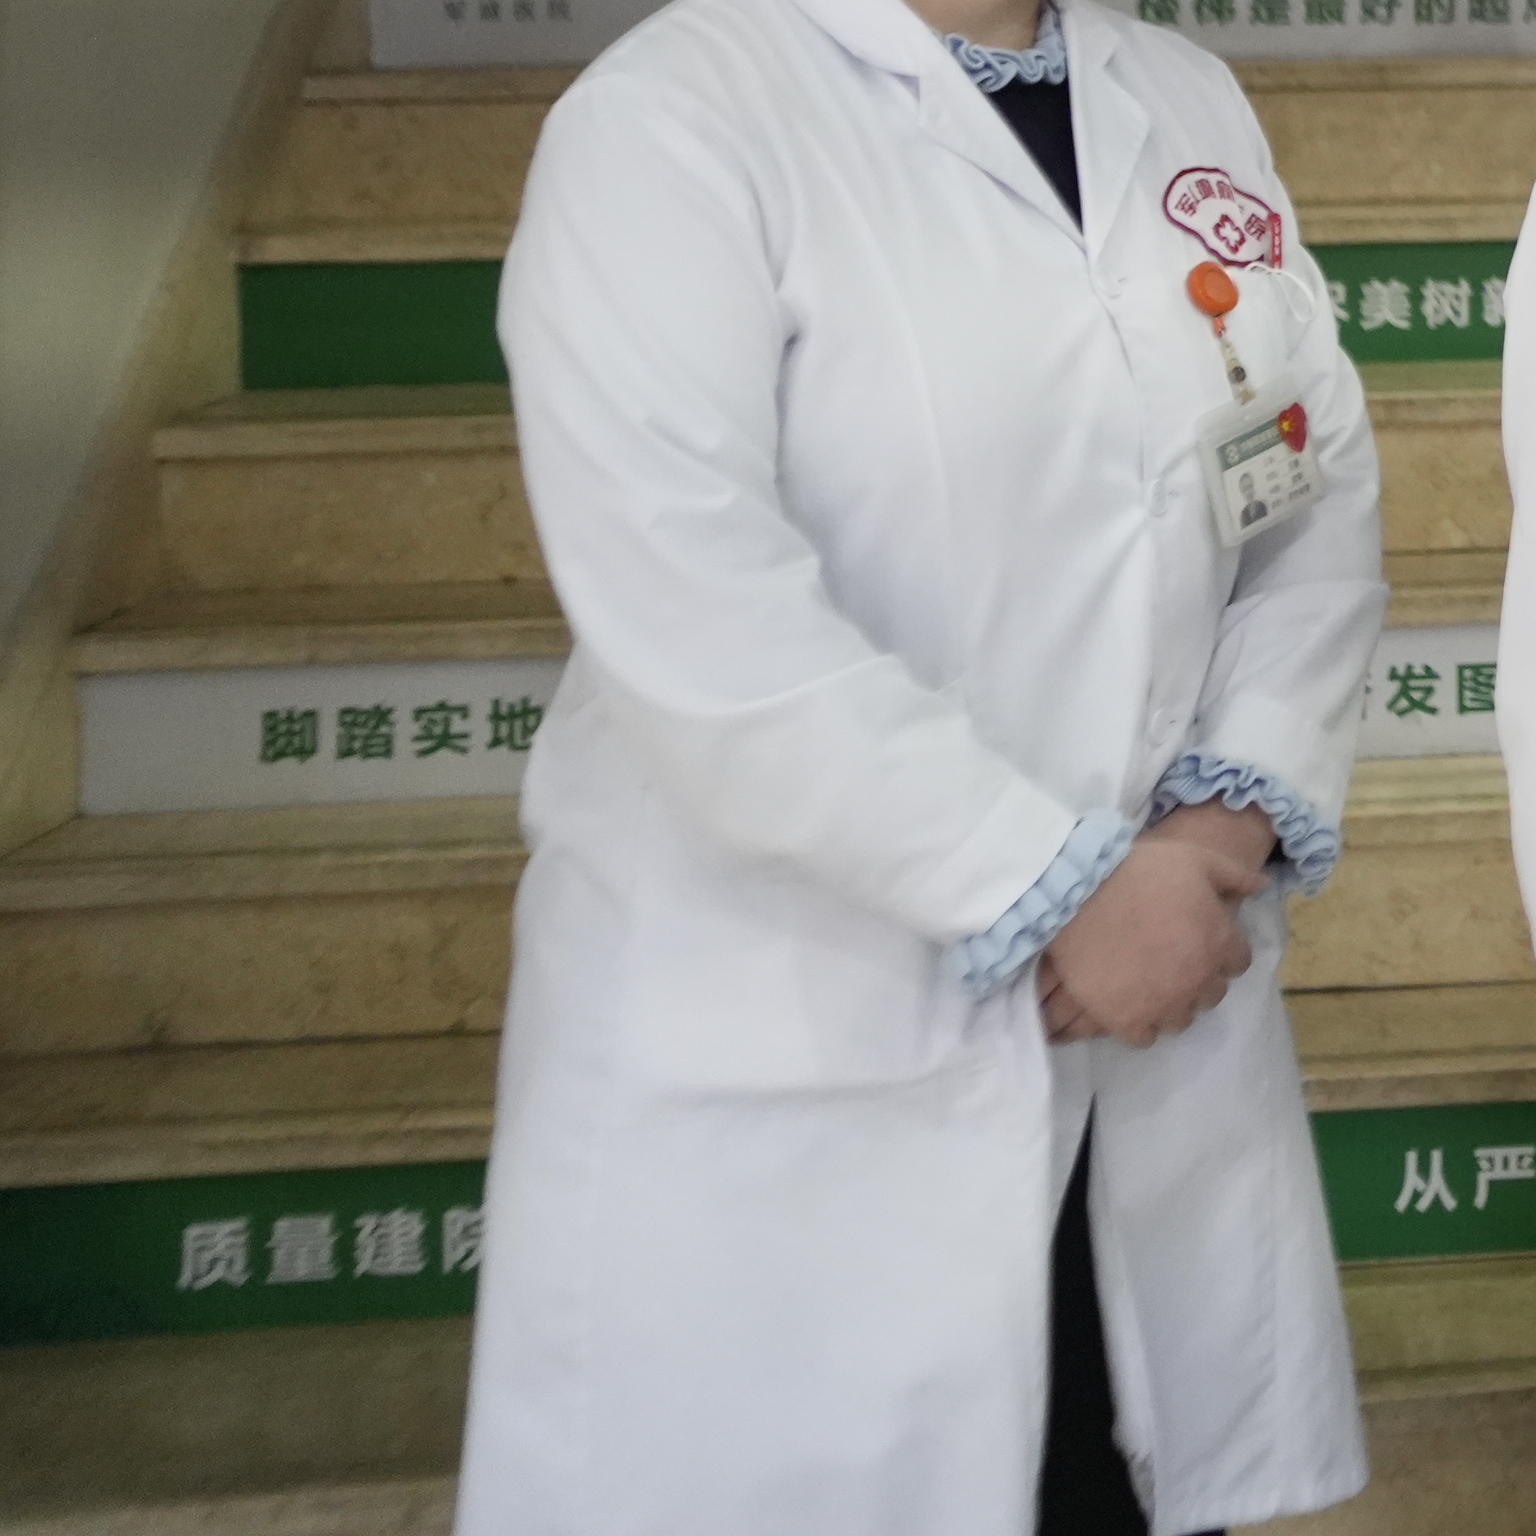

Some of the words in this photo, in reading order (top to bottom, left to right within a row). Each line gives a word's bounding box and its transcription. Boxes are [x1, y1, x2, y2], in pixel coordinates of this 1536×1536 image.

[1363, 662, 1498, 717] 发图
[259, 697, 543, 763] 脚踏实地
